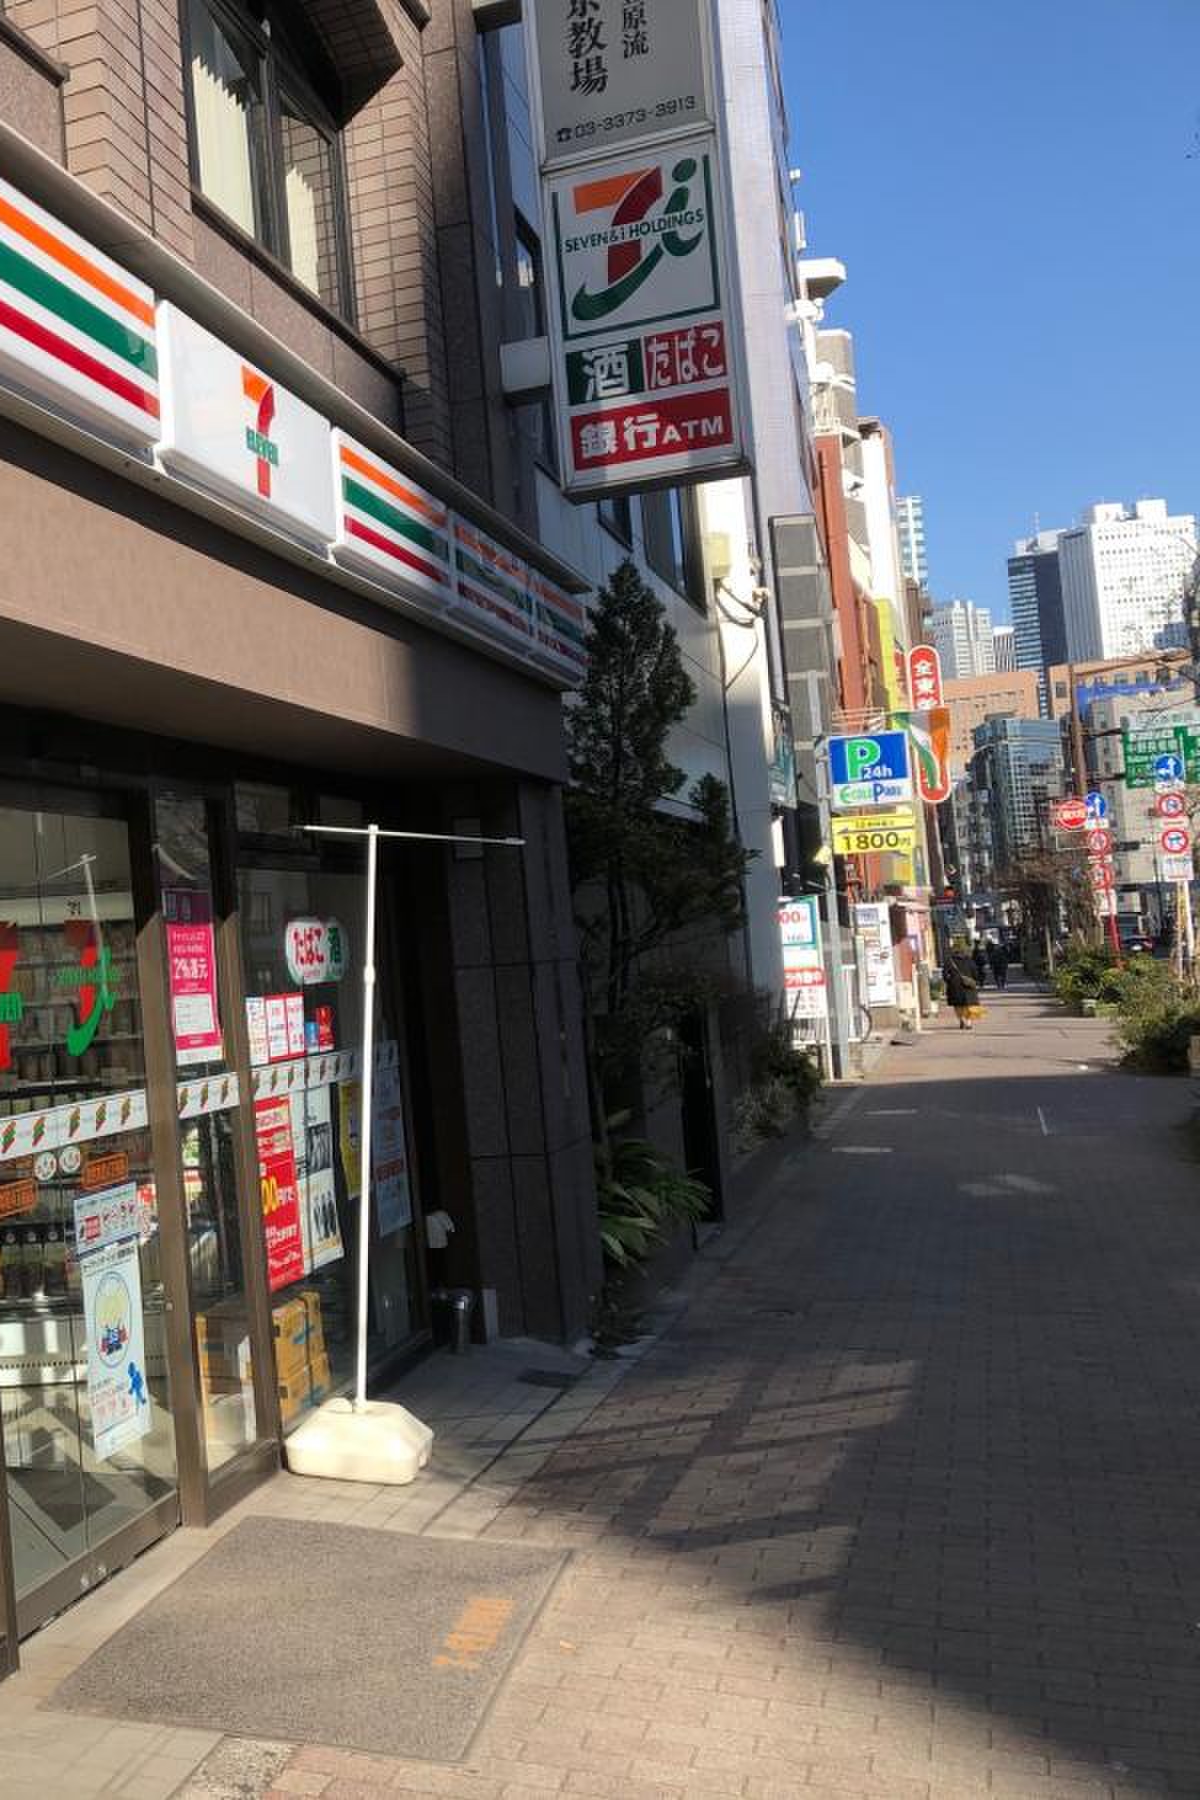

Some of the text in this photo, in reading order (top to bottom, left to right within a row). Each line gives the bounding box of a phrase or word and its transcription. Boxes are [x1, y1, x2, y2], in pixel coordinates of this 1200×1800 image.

[623, 0, 650, 59] 原流
[629, 208, 705, 239] HOLDINGS
[582, 344, 629, 399] 酒
[646, 329, 724, 388] たばこ
[579, 414, 723, 458] 銀行ATM
[863, 764, 893, 779] 24h
